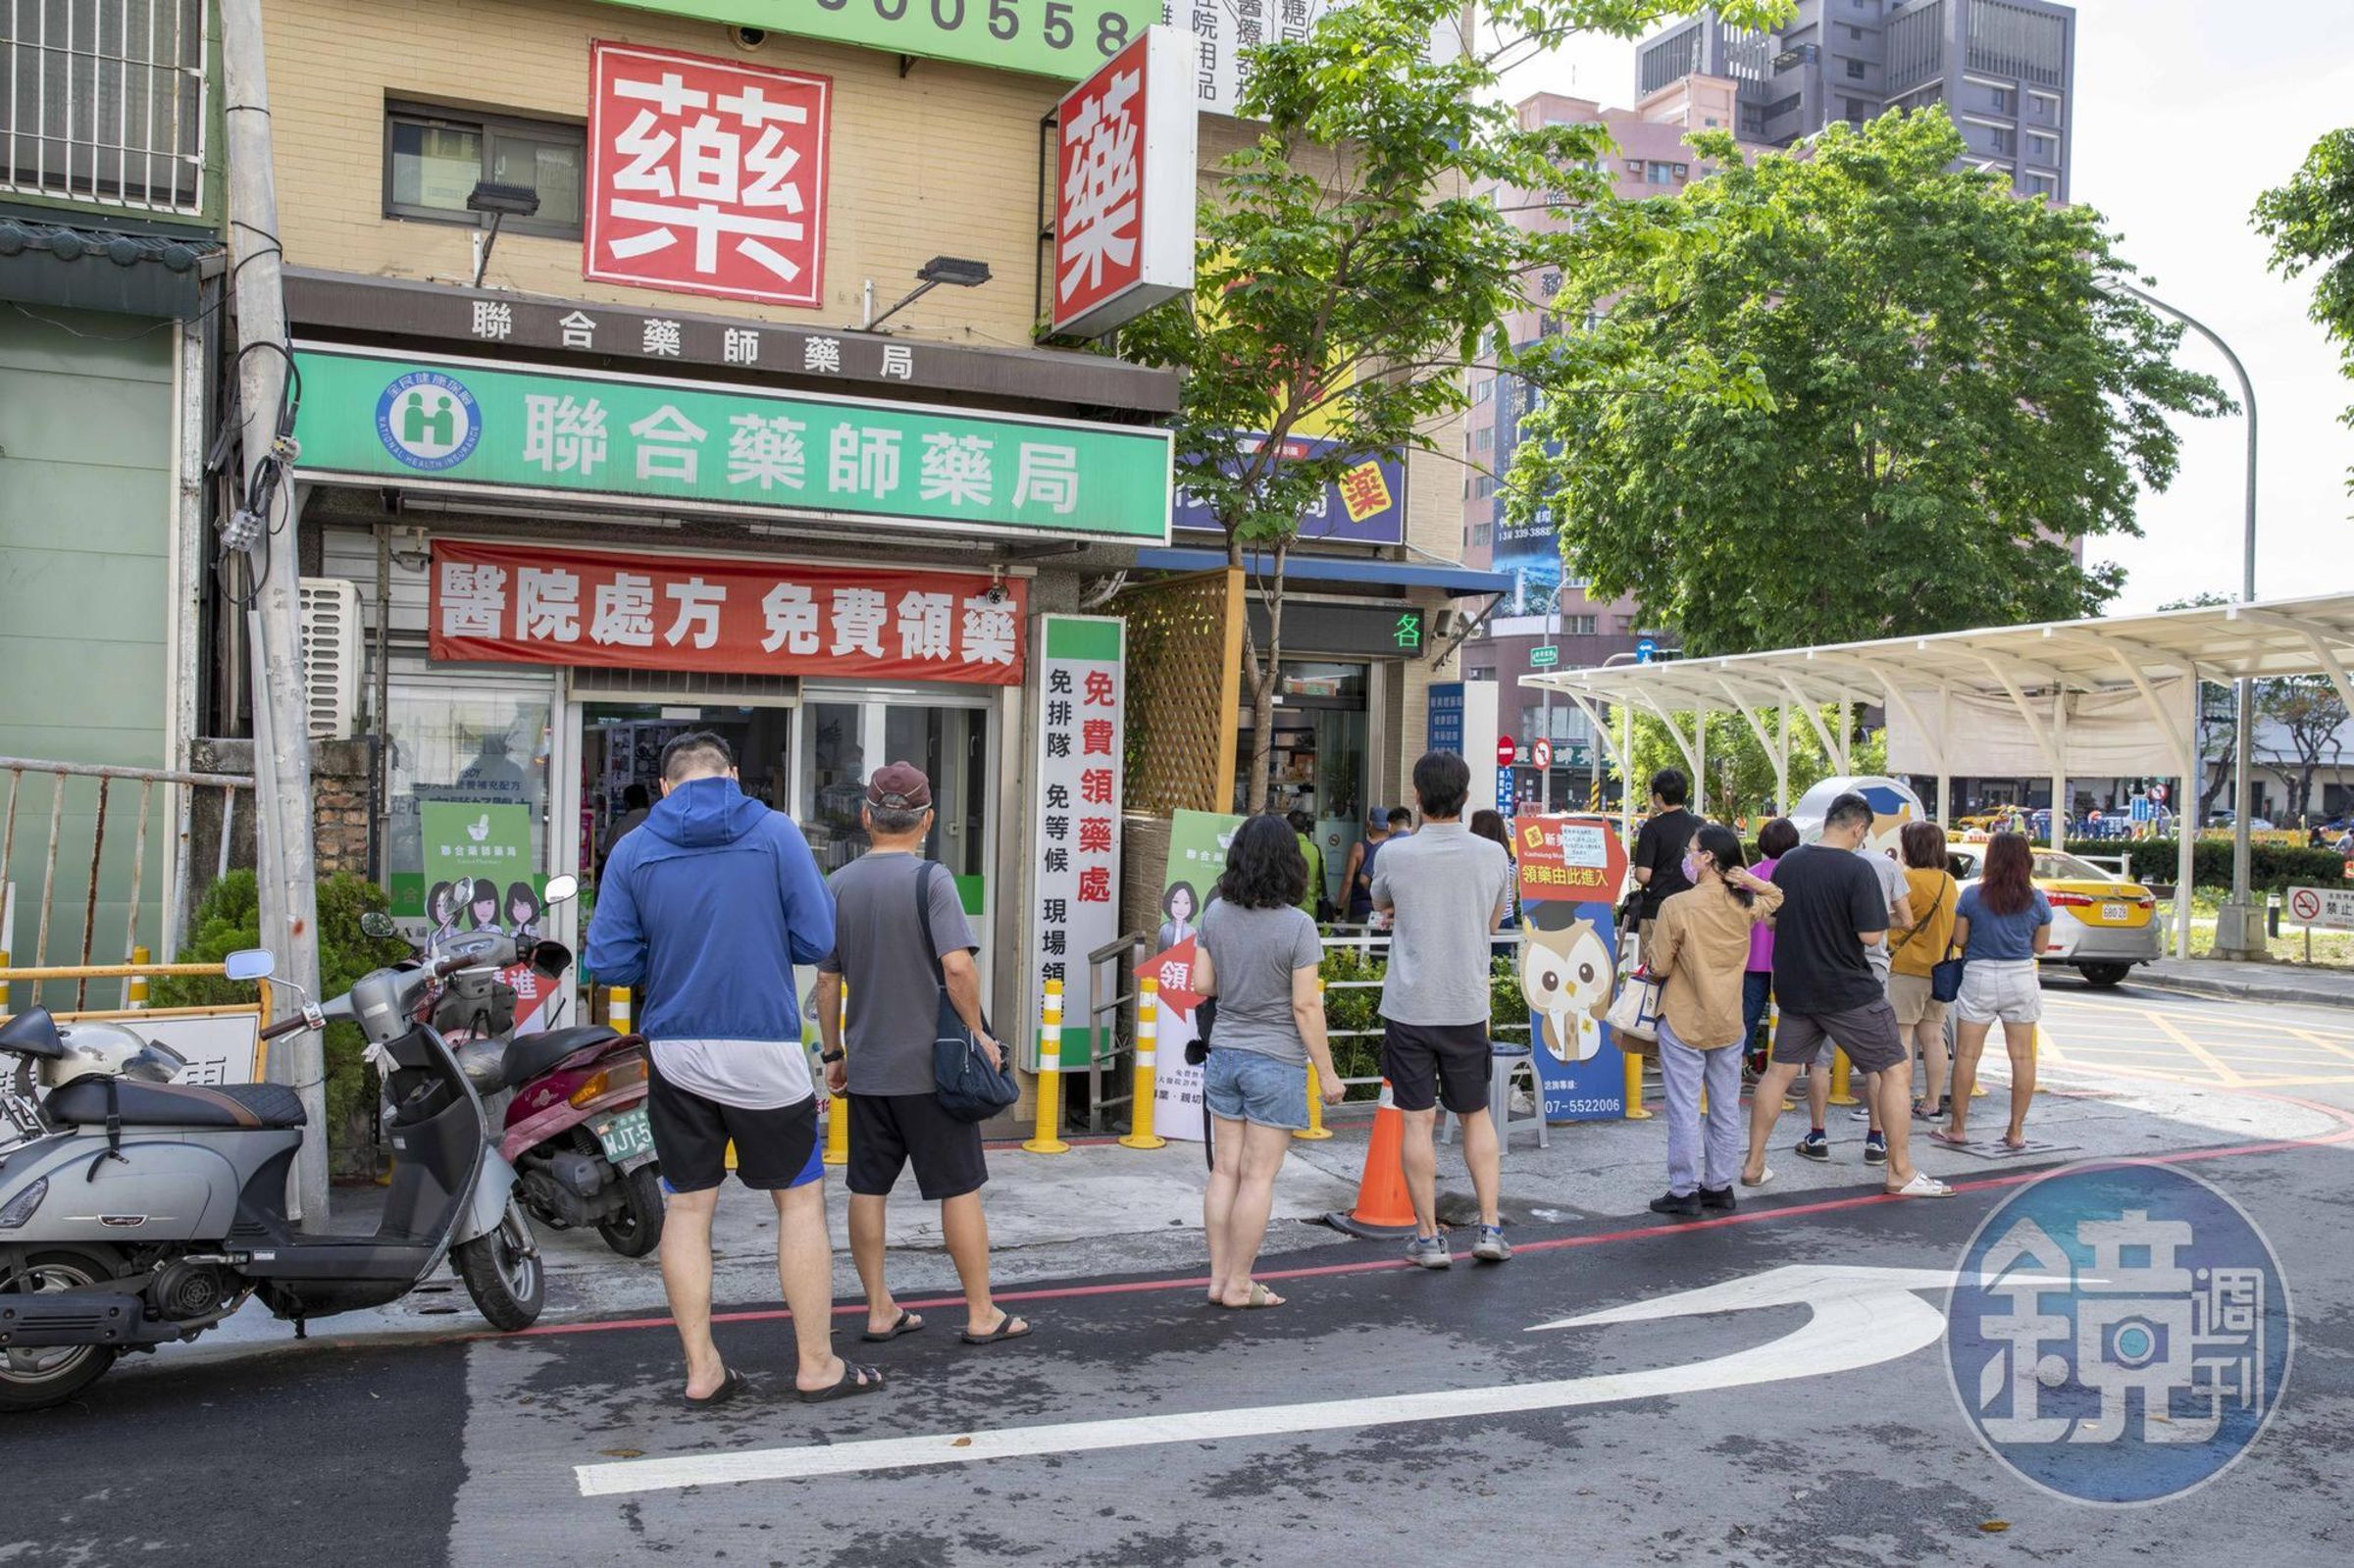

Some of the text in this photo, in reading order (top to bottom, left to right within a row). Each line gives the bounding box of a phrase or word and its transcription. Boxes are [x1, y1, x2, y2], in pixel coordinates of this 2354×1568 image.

[815, 0, 1129, 58] 0558
[609, 72, 807, 283] 藥
[1059, 65, 1142, 305] 藥
[472, 300, 913, 380] 聯合藥師藥局
[524, 393, 1080, 515] 聯合藥師藥局
[439, 562, 1016, 666] 醫院處方 免費領藥
[1393, 614, 1420, 647] 各
[1077, 670, 1115, 903] 免費領藥處
[1041, 669, 1072, 1020] 免排隊 免等候 現場領
[1522, 865, 1609, 887] 領藥由此進入
[1160, 960, 1195, 991] 領
[1545, 1098, 1621, 1114] 07-5522006
